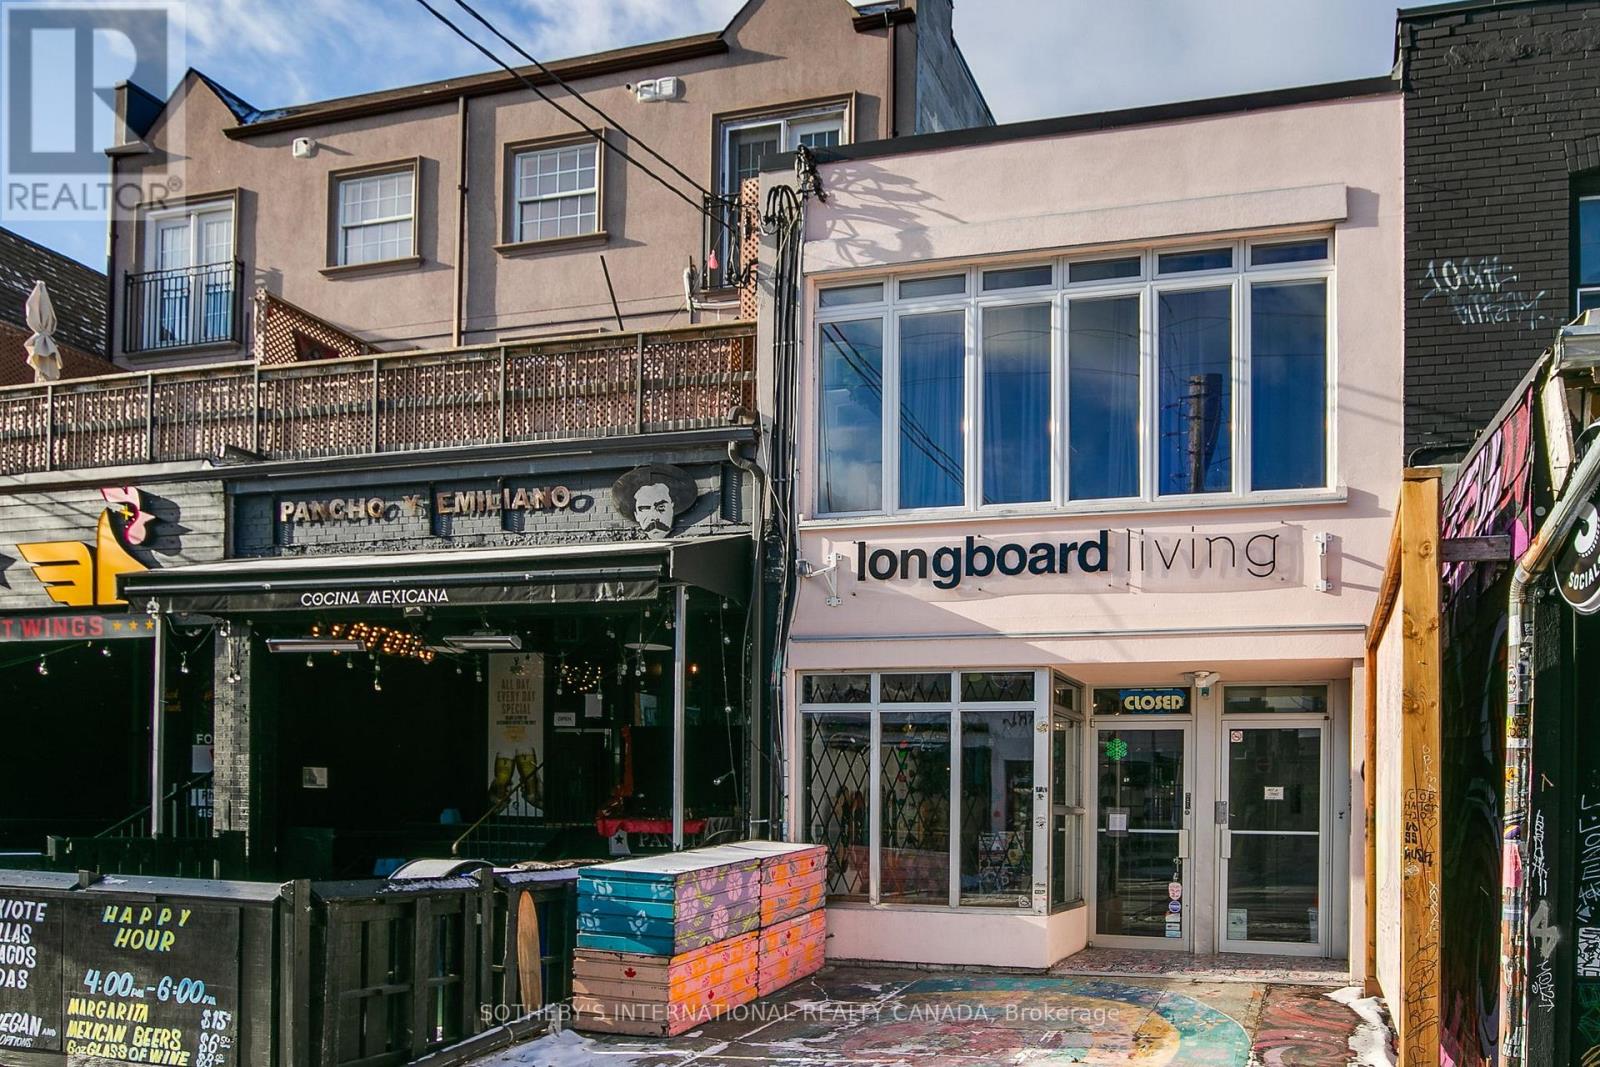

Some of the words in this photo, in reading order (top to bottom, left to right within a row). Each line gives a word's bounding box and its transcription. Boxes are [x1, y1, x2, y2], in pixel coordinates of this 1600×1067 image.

[280, 497, 384, 522] PANCHO
[403, 495, 420, 518] Y
[437, 486, 570, 514] EMILIANO
[857, 530, 1109, 589] longboard
[1127, 526, 1280, 577] living
[301, 592, 360, 606] COCINA
[367, 588, 449, 604] MEXICANA
[21, 615, 104, 638] WINGS
[1124, 695, 1184, 710] CLOSED
[102, 905, 191, 927] HAPPY
[113, 928, 175, 951] HOUR
[67, 998, 149, 1022] MARGARITA
[66, 1020, 127, 1043] MEXICAN
[132, 1026, 182, 1051] BEERS
[128, 1047, 147, 1061] OF
[150, 1049, 190, 1066] WINE
